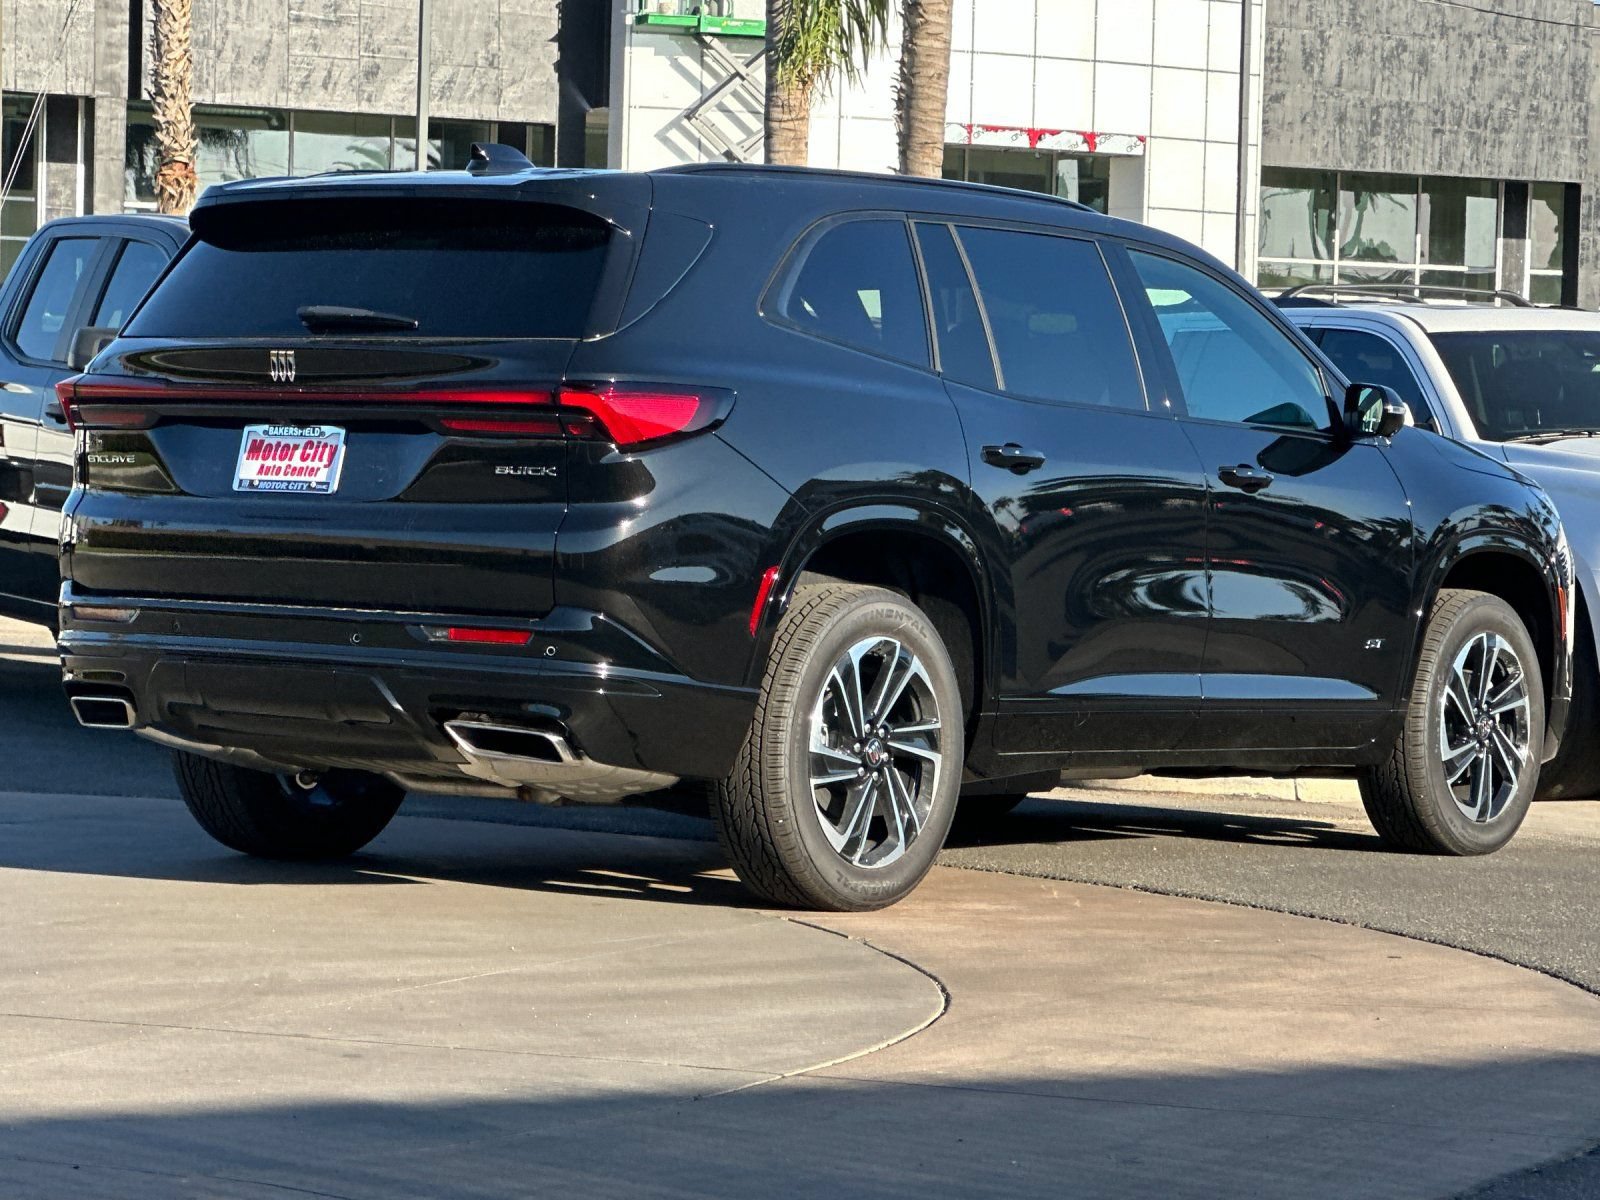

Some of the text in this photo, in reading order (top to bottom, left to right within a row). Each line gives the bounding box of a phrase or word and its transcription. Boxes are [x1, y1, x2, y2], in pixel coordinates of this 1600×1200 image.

[268, 426, 320, 437] BAKERSFIELD
[245, 439, 339, 469] Motor City
[256, 463, 321, 477] Auto Center
[494, 465, 557, 477] BUICK
[258, 481, 288, 490] MOTOR
[288, 482, 309, 491] CITY
